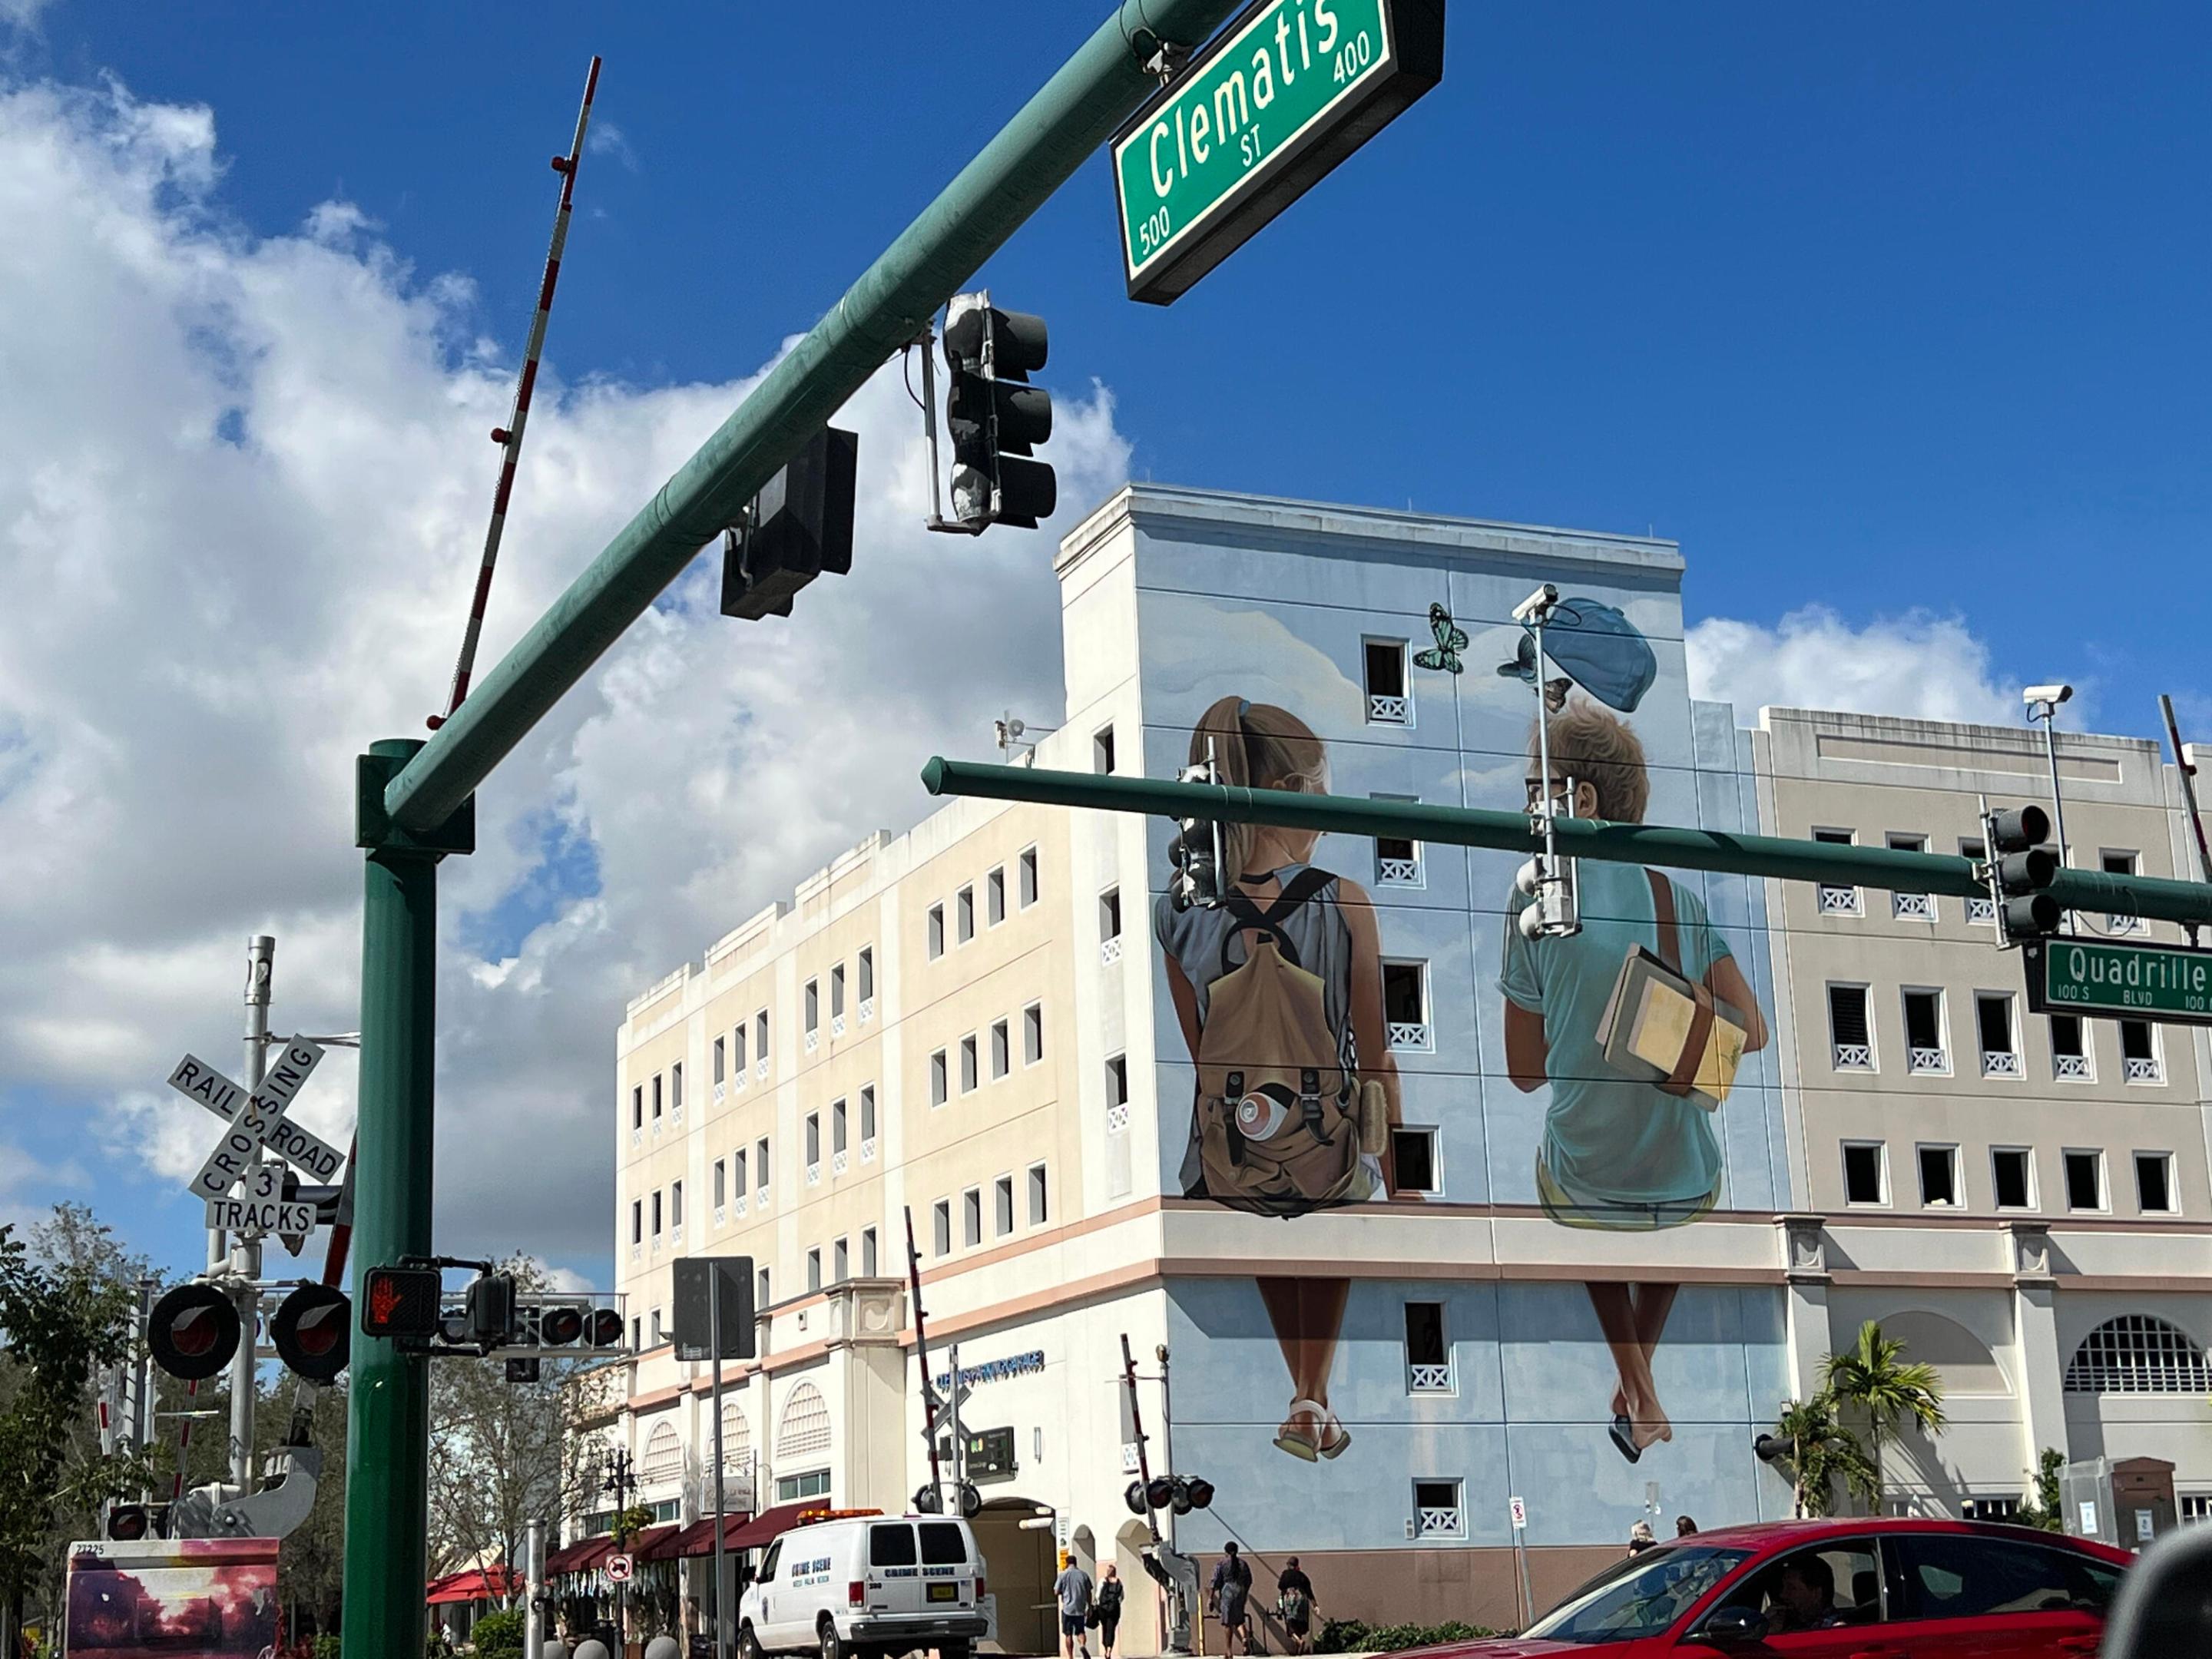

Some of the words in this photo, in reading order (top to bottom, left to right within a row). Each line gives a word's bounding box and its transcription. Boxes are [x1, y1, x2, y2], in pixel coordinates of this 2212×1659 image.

[1333, 30, 1370, 84] 400
[1149, 0, 1339, 198] Clematis
[1240, 124, 1261, 167] ST
[1138, 205, 1170, 255] 500
[2069, 947, 2207, 992] Quadrille
[2058, 984, 2078, 1000] 100
[2082, 986, 2090, 1001] S
[2123, 989, 2153, 1005] BLVD
[2185, 995, 2204, 1011] 100
[176, 1061, 235, 1115] RAIL
[204, 1048, 313, 1191] CROSSING
[270, 1124, 336, 1178] ROAD
[255, 1172, 273, 1197] 3
[214, 1200, 310, 1232] TRACKS
[77, 1544, 104, 1555] 27225
